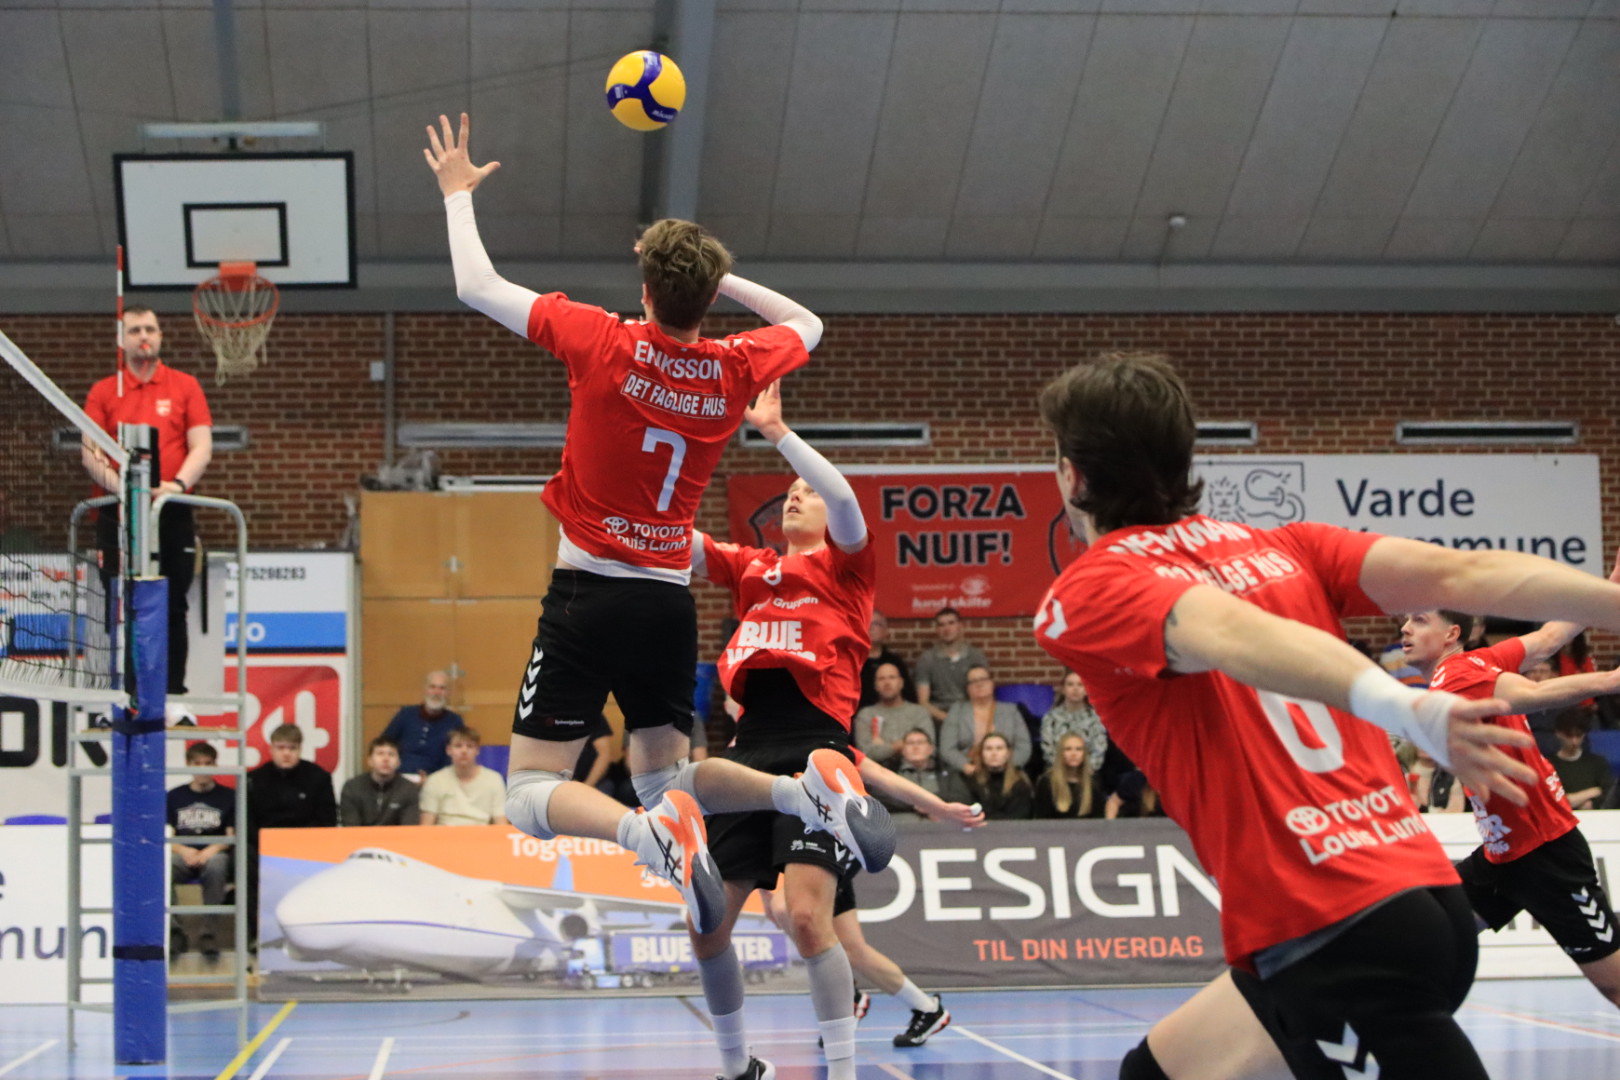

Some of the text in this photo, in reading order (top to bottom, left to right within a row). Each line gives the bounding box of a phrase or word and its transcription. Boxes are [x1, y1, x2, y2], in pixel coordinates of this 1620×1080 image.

[624, 374, 726, 416] DET FAGLIGE HUS
[641, 426, 687, 512] 7
[882, 485, 1024, 520] FORZA
[1337, 478, 1475, 516] Varde
[632, 522, 684, 538] TOYOTA
[897, 533, 1012, 566] NUIF!
[1323, 785, 1404, 825] TOYOT
[1299, 827, 1380, 866] Louis
[631, 936, 693, 963] BLUE
[973, 935, 1204, 961] TIL DIN HVERDAG
